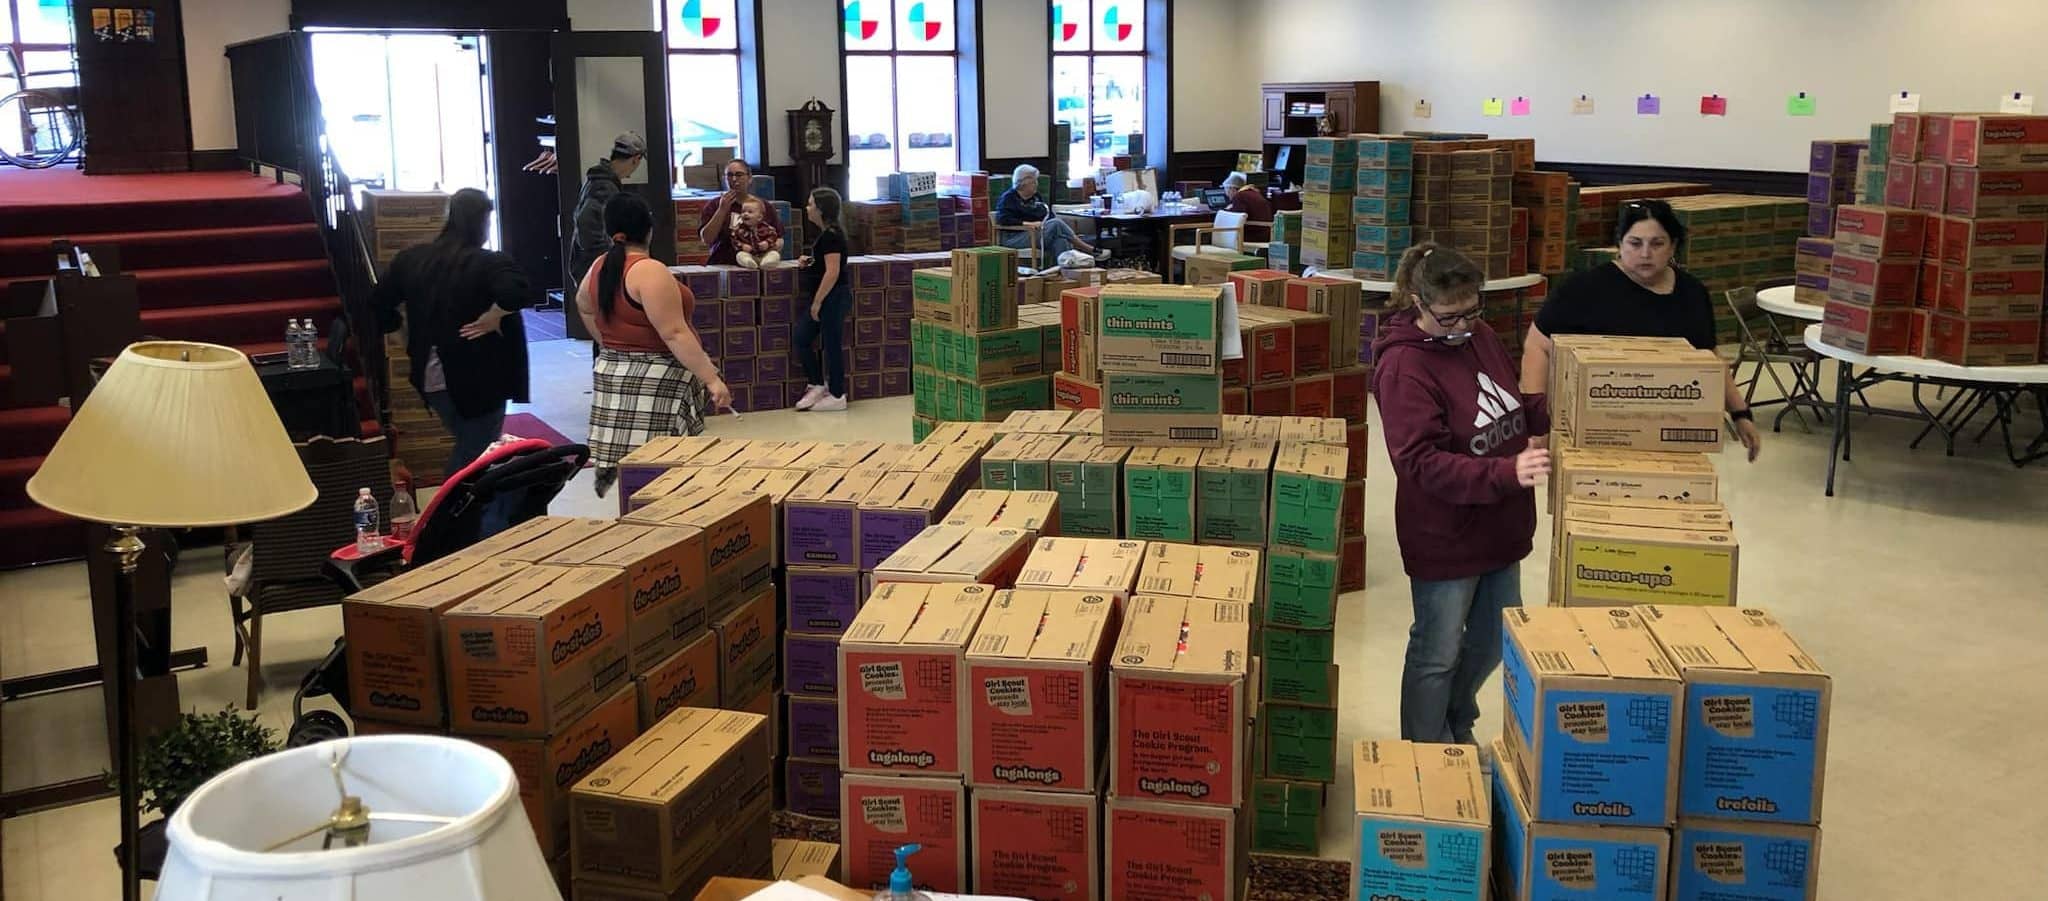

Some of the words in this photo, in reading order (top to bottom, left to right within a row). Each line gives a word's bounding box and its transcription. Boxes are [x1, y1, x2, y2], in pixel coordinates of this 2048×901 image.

[1106, 316, 1133, 329] thin
[1135, 318, 1174, 330] mints
[1590, 384, 1702, 400] adventurefuls
[1112, 393, 1138, 405] thin
[1141, 394, 1181, 406] mints
[1577, 564, 1673, 589] lemon-ups
[860, 665, 875, 673] Girl
[876, 664, 899, 673] Scout
[985, 680, 1000, 688] Girl
[1001, 679, 1025, 688] Scout
[1724, 698, 1750, 706] Scout
[1559, 705, 1576, 713] Girl
[1578, 704, 1605, 712] Scout
[1133, 730, 1150, 738] The
[1152, 731, 1171, 740] Girl
[1174, 732, 1201, 742] Scout
[1132, 740, 1165, 750] Cookie
[869, 750, 935, 766] tagalongs
[994, 766, 1061, 783] tagalongs
[1140, 778, 1209, 796] tagalongs
[862, 799, 876, 807] Girl
[1574, 802, 1633, 816] trefoils
[1717, 797, 1777, 813] trefoils
[1380, 832, 1396, 840] Girl
[1397, 832, 1422, 840] Scout
[1548, 852, 1565, 860] Girl
